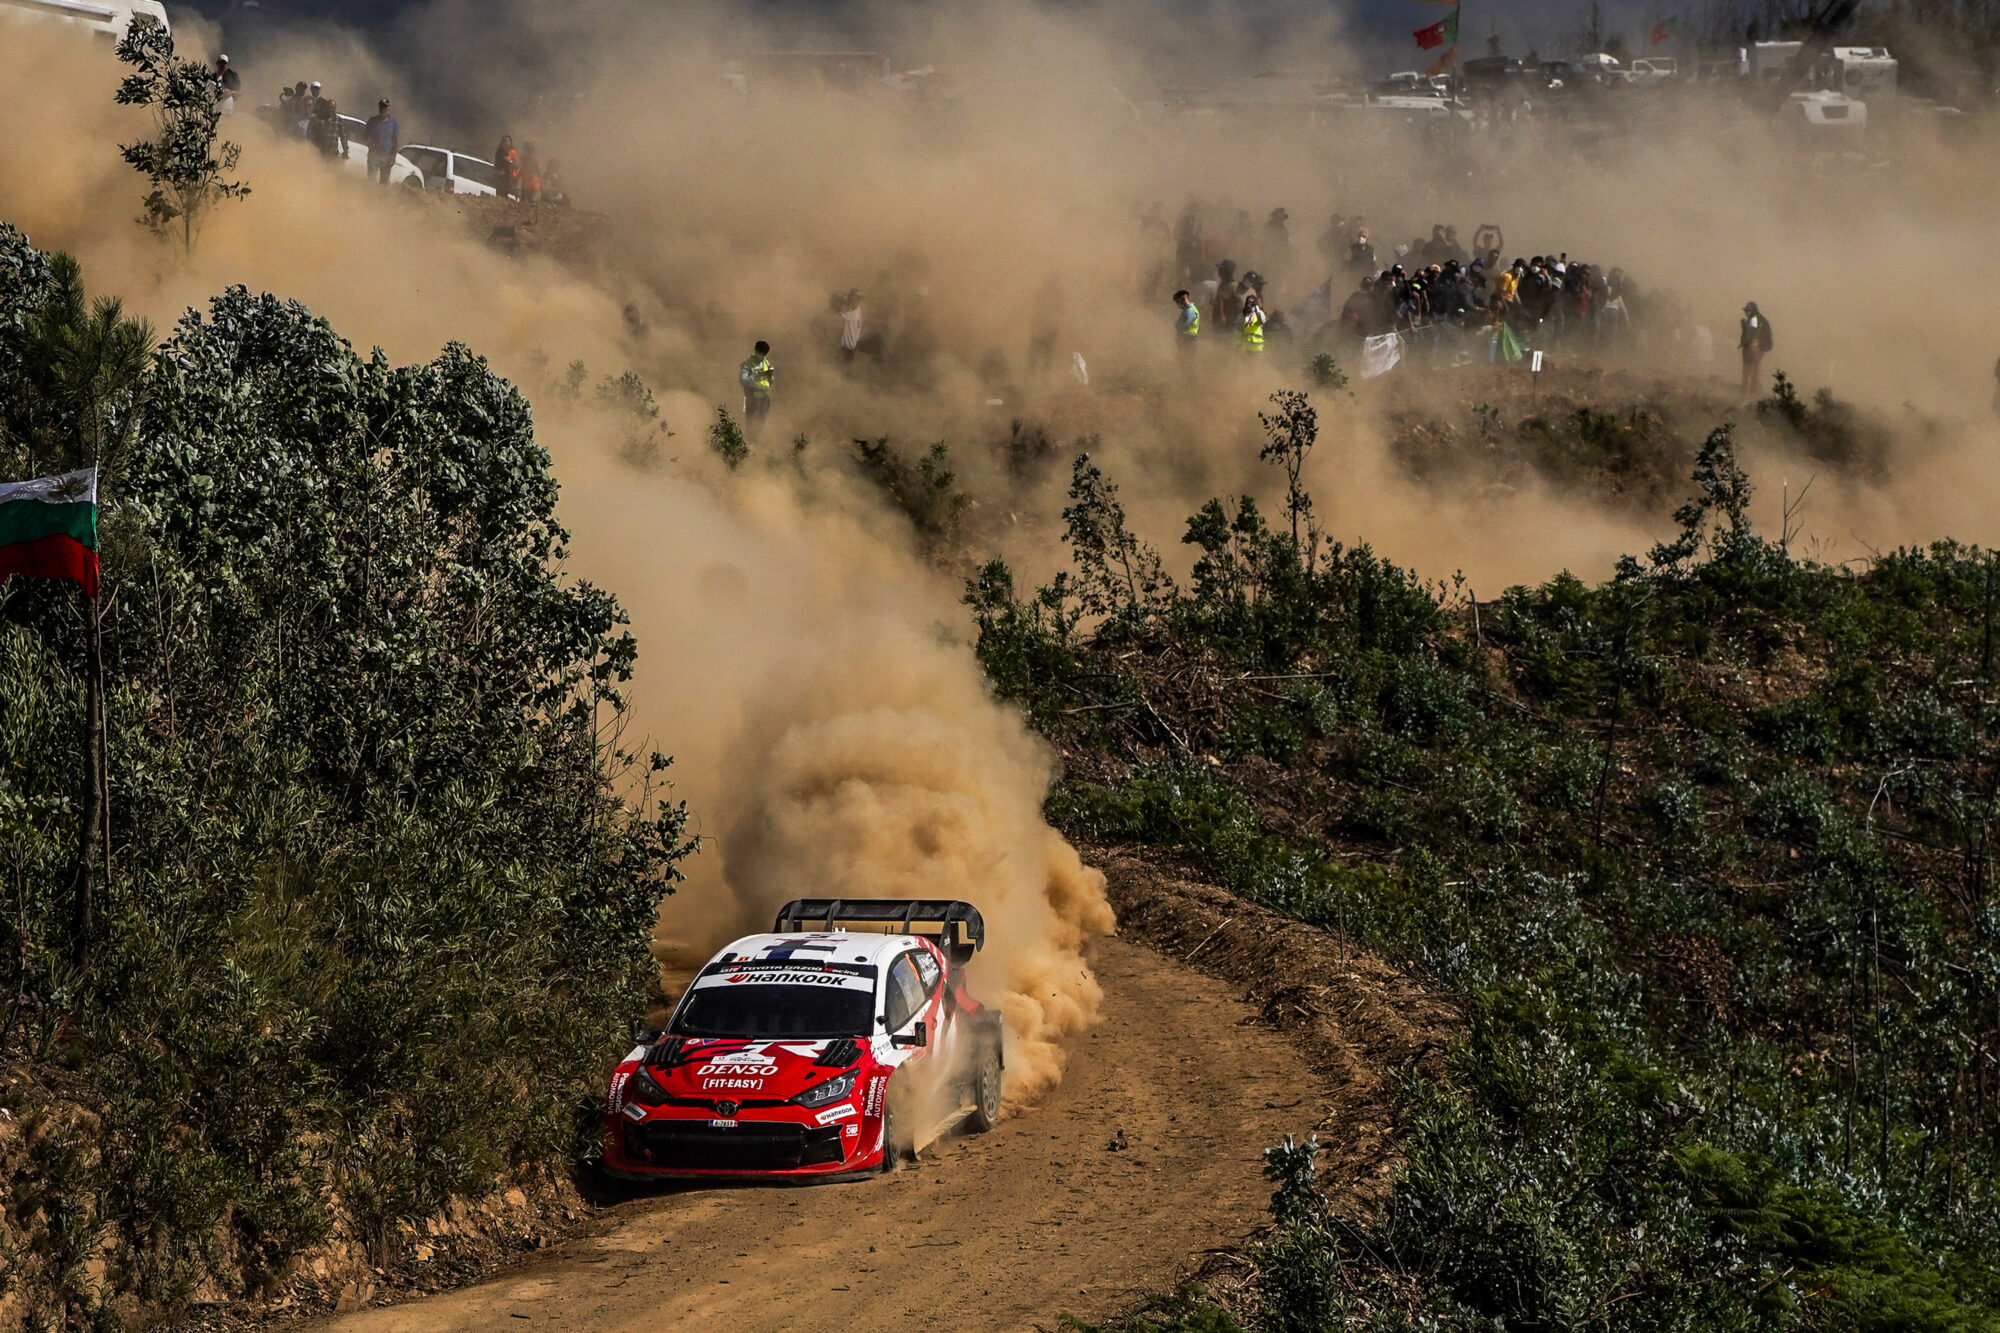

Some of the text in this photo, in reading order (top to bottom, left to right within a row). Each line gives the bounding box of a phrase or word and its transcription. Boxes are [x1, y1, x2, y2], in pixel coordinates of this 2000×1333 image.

[823, 967, 859, 976] Racing
[697, 1065, 778, 1076] DENSO
[607, 1072, 620, 1115] AUTOMOTIVE
[615, 1072, 630, 1113] Panasonic
[864, 1076, 879, 1116] Panasonic
[874, 1076, 887, 1118] AUTOMOTIVE
